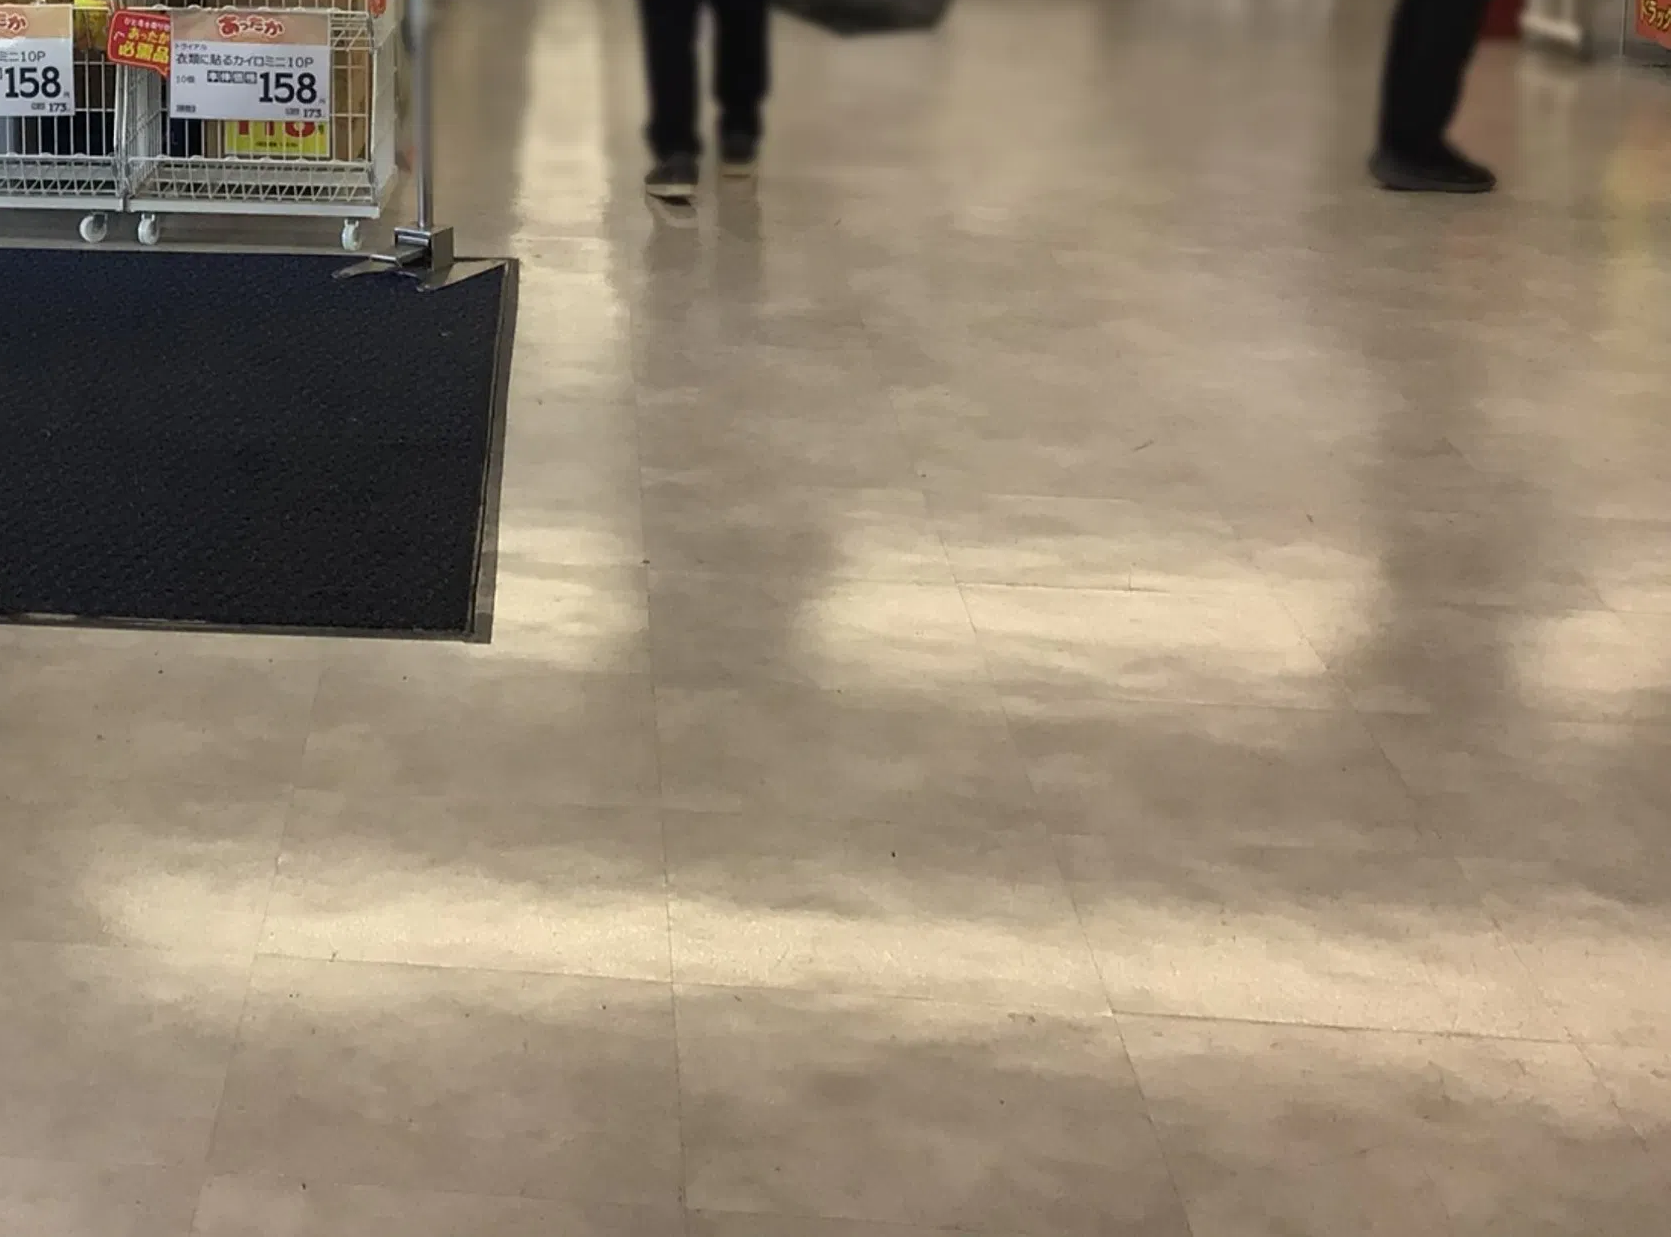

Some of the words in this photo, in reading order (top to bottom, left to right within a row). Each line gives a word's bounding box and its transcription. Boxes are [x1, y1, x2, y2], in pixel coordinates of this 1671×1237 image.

[219, 14, 284, 37] あったか
[176, 53, 314, 68] 衣類に貼るカイロミニ10P
[5, 66, 62, 98] 158
[259, 73, 317, 104] 158
